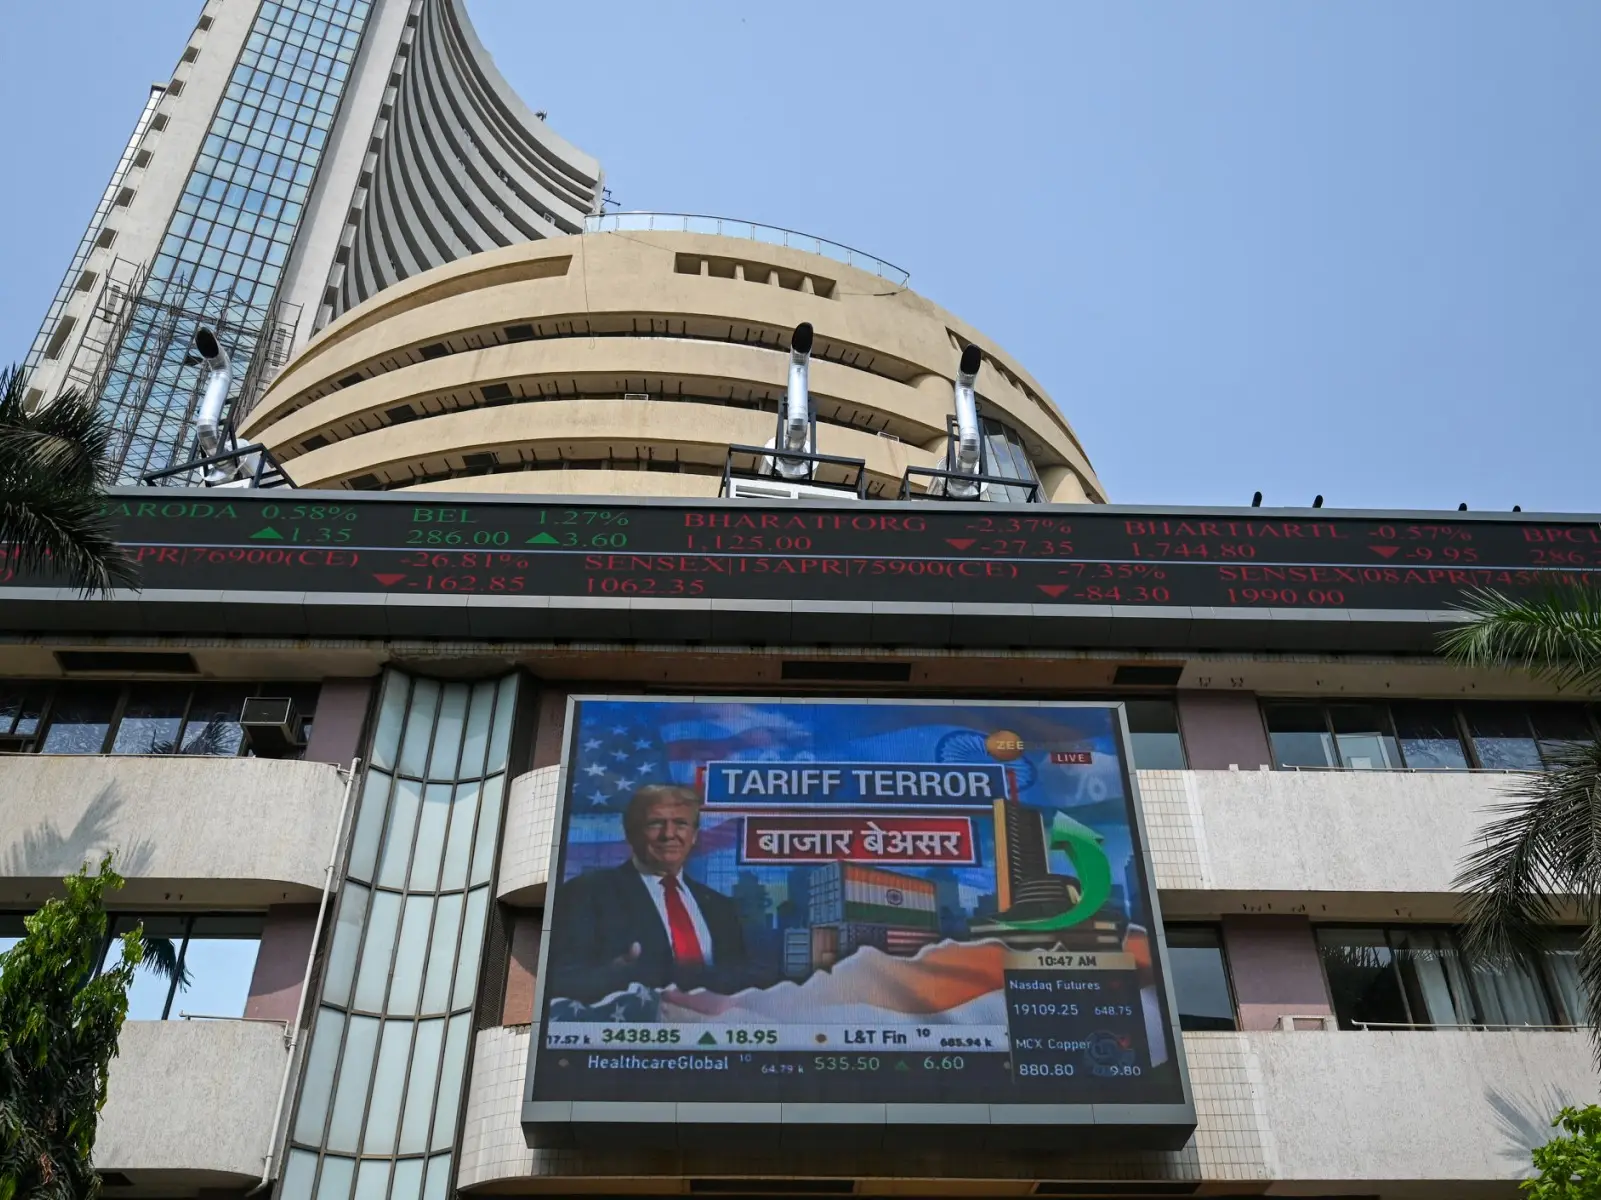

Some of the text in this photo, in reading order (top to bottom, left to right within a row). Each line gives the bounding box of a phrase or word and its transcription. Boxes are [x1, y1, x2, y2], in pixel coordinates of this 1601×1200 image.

[261, 504, 357, 521] 0.58%
[413, 507, 629, 526] BEL 1.27%
[684, 513, 1072, 534] BHARATFORG -2.37%
[292, 527, 353, 543] 1.35
[405, 530, 628, 548] 286.00 3.60
[980, 539, 1074, 555] -27.35
[401, 551, 530, 570] -26.81%
[1057, 563, 1166, 580] -7.35%
[408, 574, 526, 592] -162.85
[587, 577, 1171, 602] 1062.35 -84.30
[1228, 588, 1346, 606] 1990.00
[996, 740, 1025, 751] ZEE
[1057, 753, 1086, 763] LIVE
[722, 768, 993, 798] TARIFF TERROR
[756, 820, 962, 856] बाजार बेअसर
[1038, 956, 1098, 967] 10:47 AM
[1009, 980, 1101, 992] Nasdaq Futures
[1013, 1004, 1079, 1016] 19109.25
[602, 1028, 681, 1044] 3438.85
[726, 1029, 778, 1045] 18.95
[844, 1030, 876, 1045] L&T
[882, 1030, 907, 1045] Fin
[916, 1028, 931, 1038] 10
[1016, 1038, 1091, 1051] MCX Copper
[587, 1054, 729, 1071] HealthcareGlobal
[814, 1056, 880, 1071] 535.50
[923, 1055, 964, 1070] 6.60
[1020, 1063, 1142, 1077] 880.80 9.80
